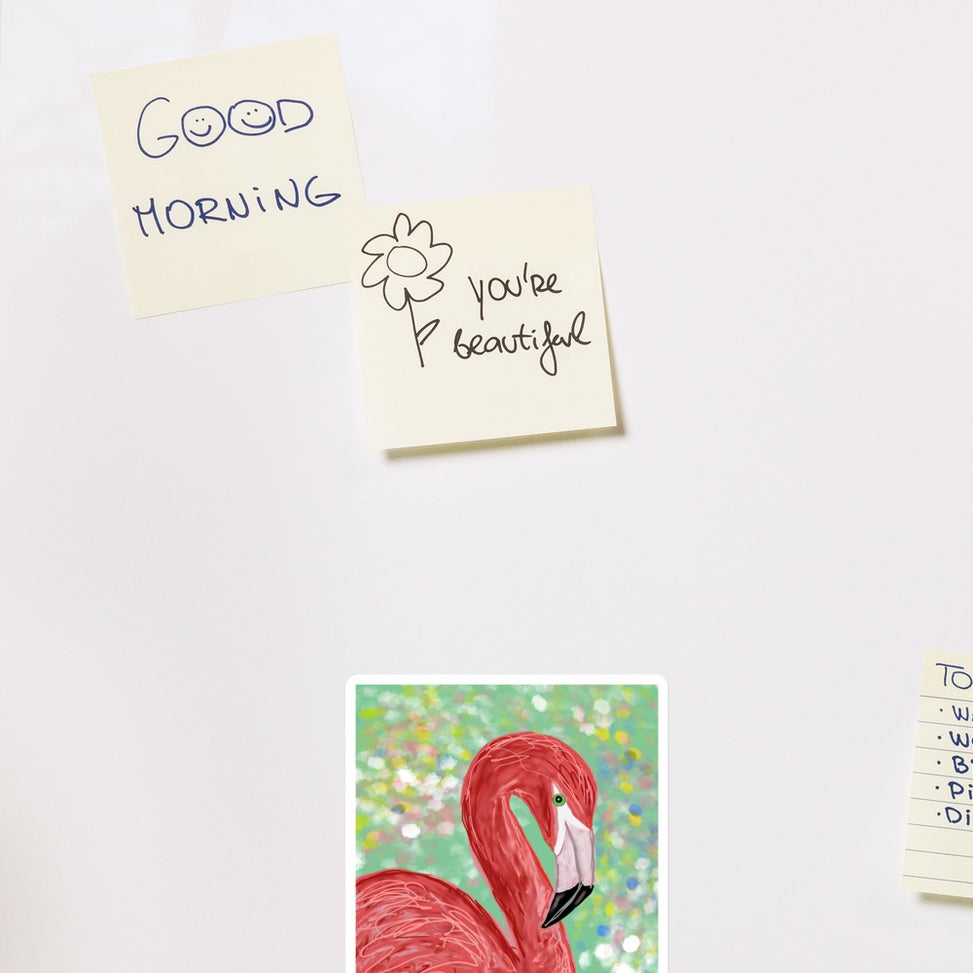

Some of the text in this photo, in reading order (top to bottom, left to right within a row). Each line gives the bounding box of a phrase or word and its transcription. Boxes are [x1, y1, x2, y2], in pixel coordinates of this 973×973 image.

[137, 97, 314, 158] GOOD
[453, 311, 591, 376] beautiful
[936, 663, 973, 690] TO
